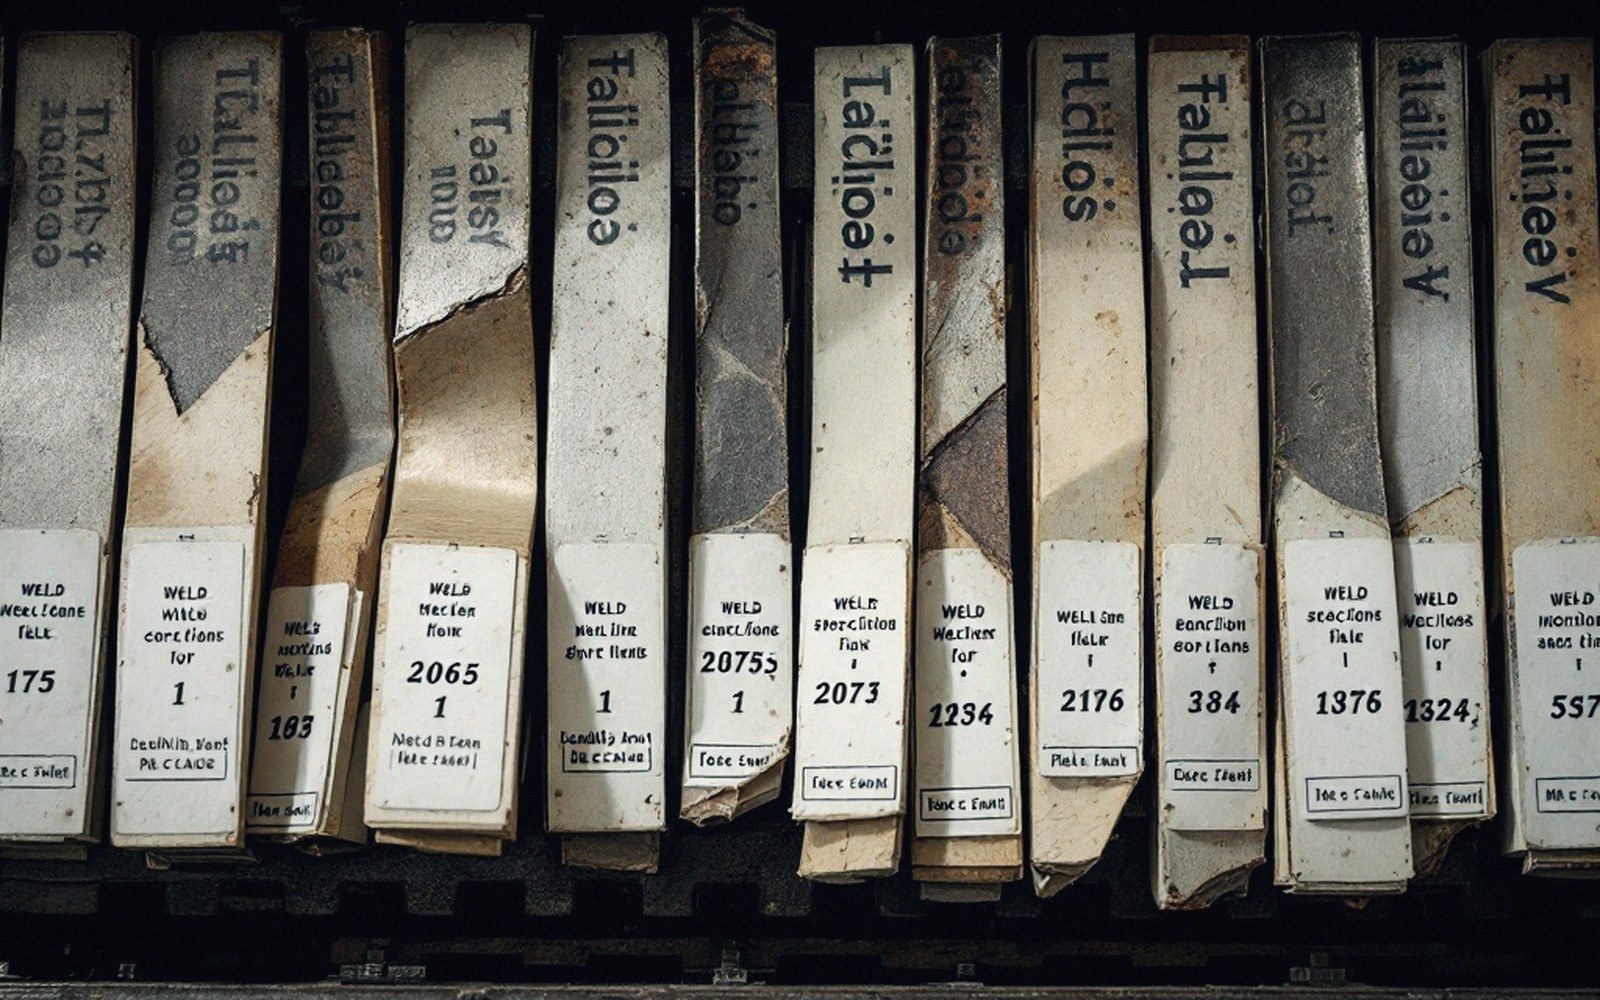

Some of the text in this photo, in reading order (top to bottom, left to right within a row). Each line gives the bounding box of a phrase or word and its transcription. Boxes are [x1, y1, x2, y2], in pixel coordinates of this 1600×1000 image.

[22, 583, 65, 597] WELD
[164, 586, 207, 600] WELD
[1325, 586, 1368, 600] WELD
[1414, 592, 1458, 606] WELD
[585, 601, 626, 615] WELD
[721, 601, 761, 614] WELD
[942, 604, 985, 620] WELD
[1189, 595, 1233, 610] WELD
[8, 670, 55, 693] 175
[407, 661, 479, 685] 2065
[596, 690, 611, 713] 1
[732, 691, 744, 713] 1
[814, 682, 880, 704] 2073
[1060, 689, 1124, 712] 2176
[1188, 690, 1241, 714] 384
[1316, 690, 1382, 715] 1376
[434, 696, 446, 718] 1
[1404, 699, 1470, 723] 1324
